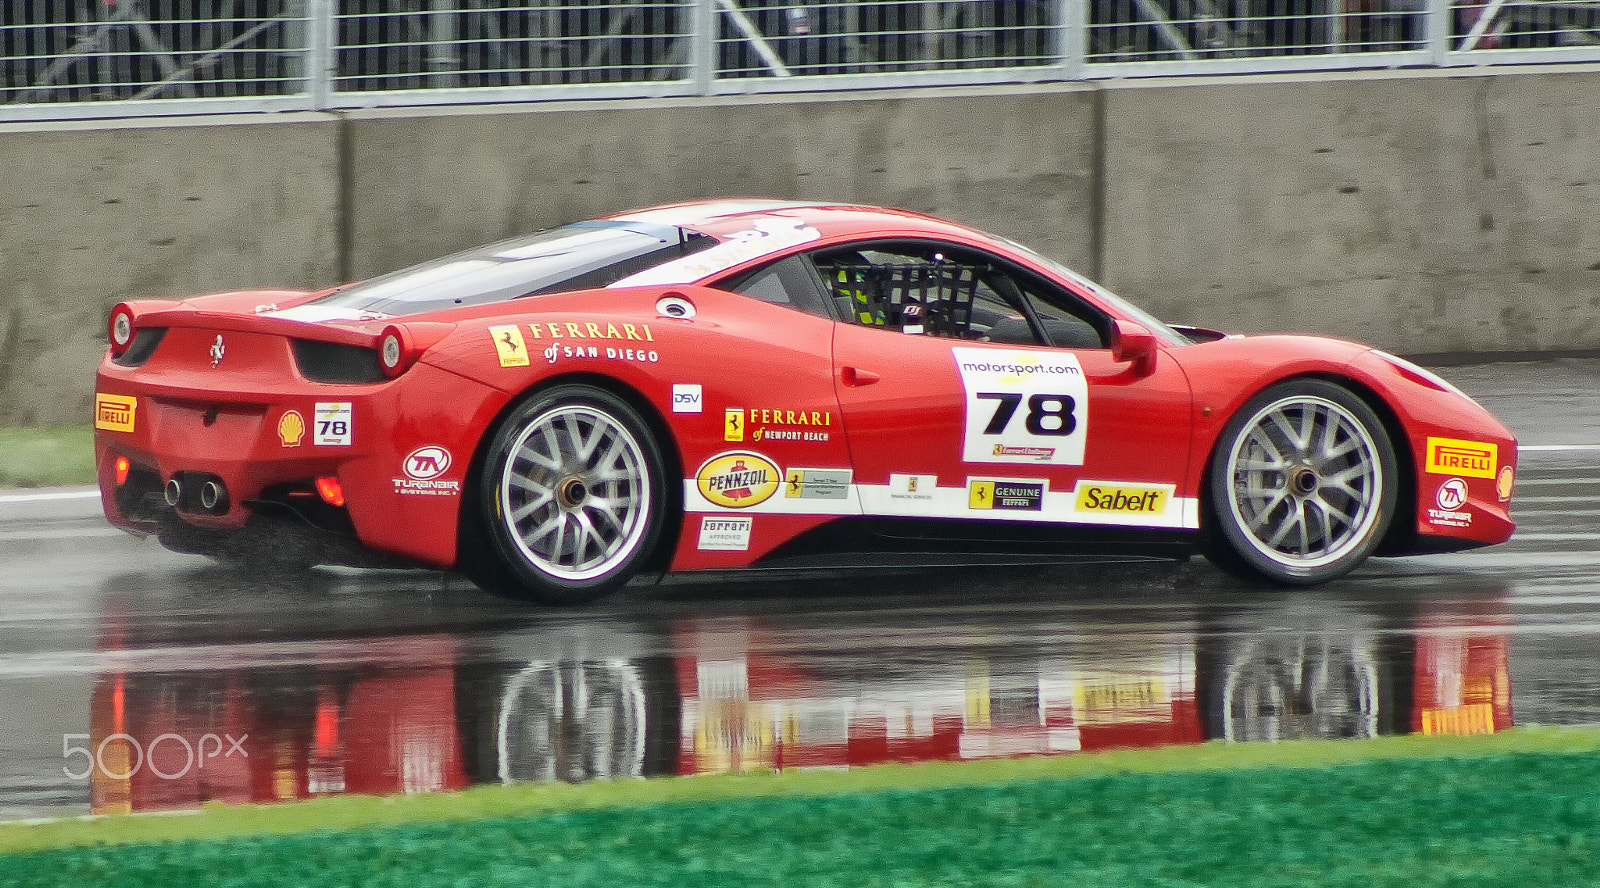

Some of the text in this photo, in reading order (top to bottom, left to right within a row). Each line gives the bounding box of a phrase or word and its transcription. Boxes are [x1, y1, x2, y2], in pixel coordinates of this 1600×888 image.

[528, 322, 654, 342] FERRARI
[544, 342, 659, 363] of SAN DIEGO
[963, 362, 1079, 376] motorsport.com
[674, 393, 699, 403] DSV
[98, 401, 131, 425] PIRELLI
[750, 408, 830, 426] FERRARI
[976, 392, 1077, 436] 78
[317, 421, 347, 436] 78
[752, 427, 765, 442] of
[764, 430, 801, 440] NEWPORT
[804, 432, 829, 441] BEACH
[1434, 445, 1491, 471] PIRELLI
[708, 468, 769, 492] PENNZOIL
[995, 487, 1041, 497] GENUINE
[1085, 487, 1159, 511] Sabelt
[1002, 498, 1030, 507] Ferrari
[703, 520, 750, 531] Ferrari
